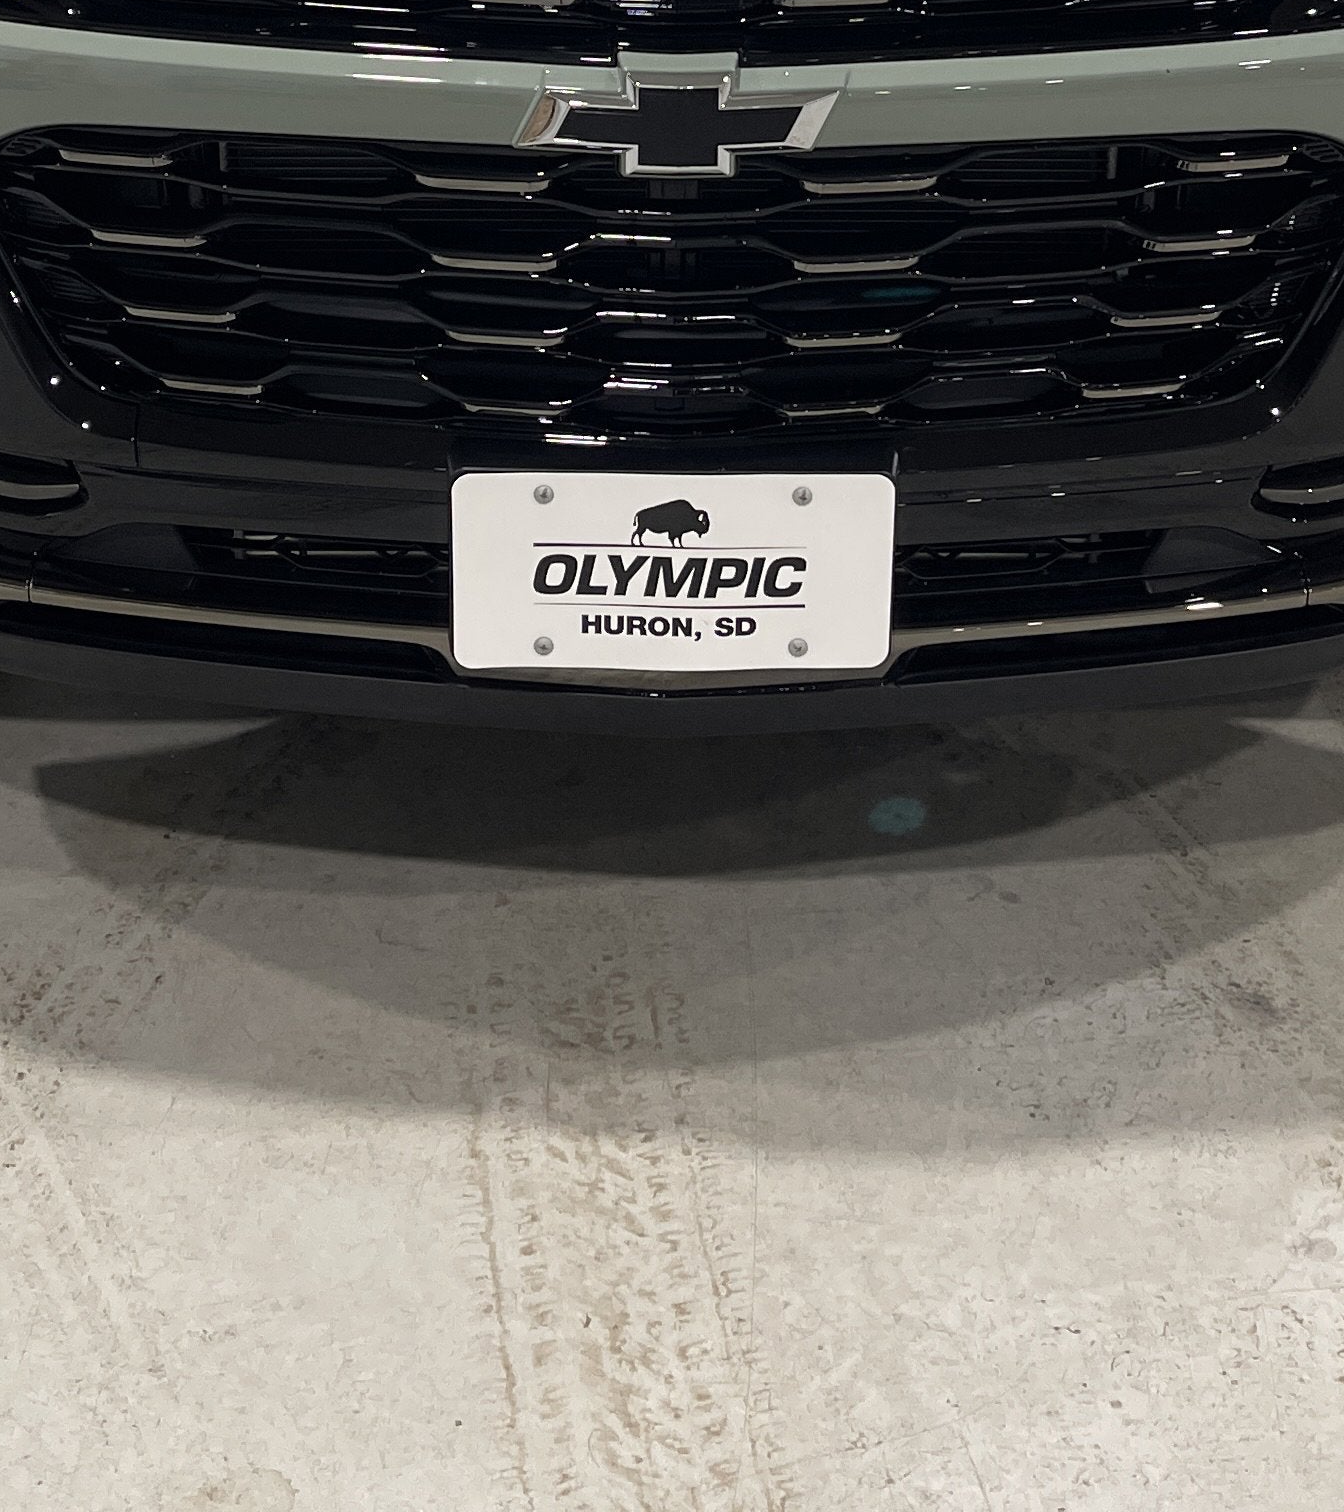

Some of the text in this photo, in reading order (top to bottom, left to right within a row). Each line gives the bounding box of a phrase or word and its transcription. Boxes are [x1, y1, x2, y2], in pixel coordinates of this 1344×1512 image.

[533, 554, 807, 599] OLYMPIC
[581, 614, 757, 641] HURON, SD
